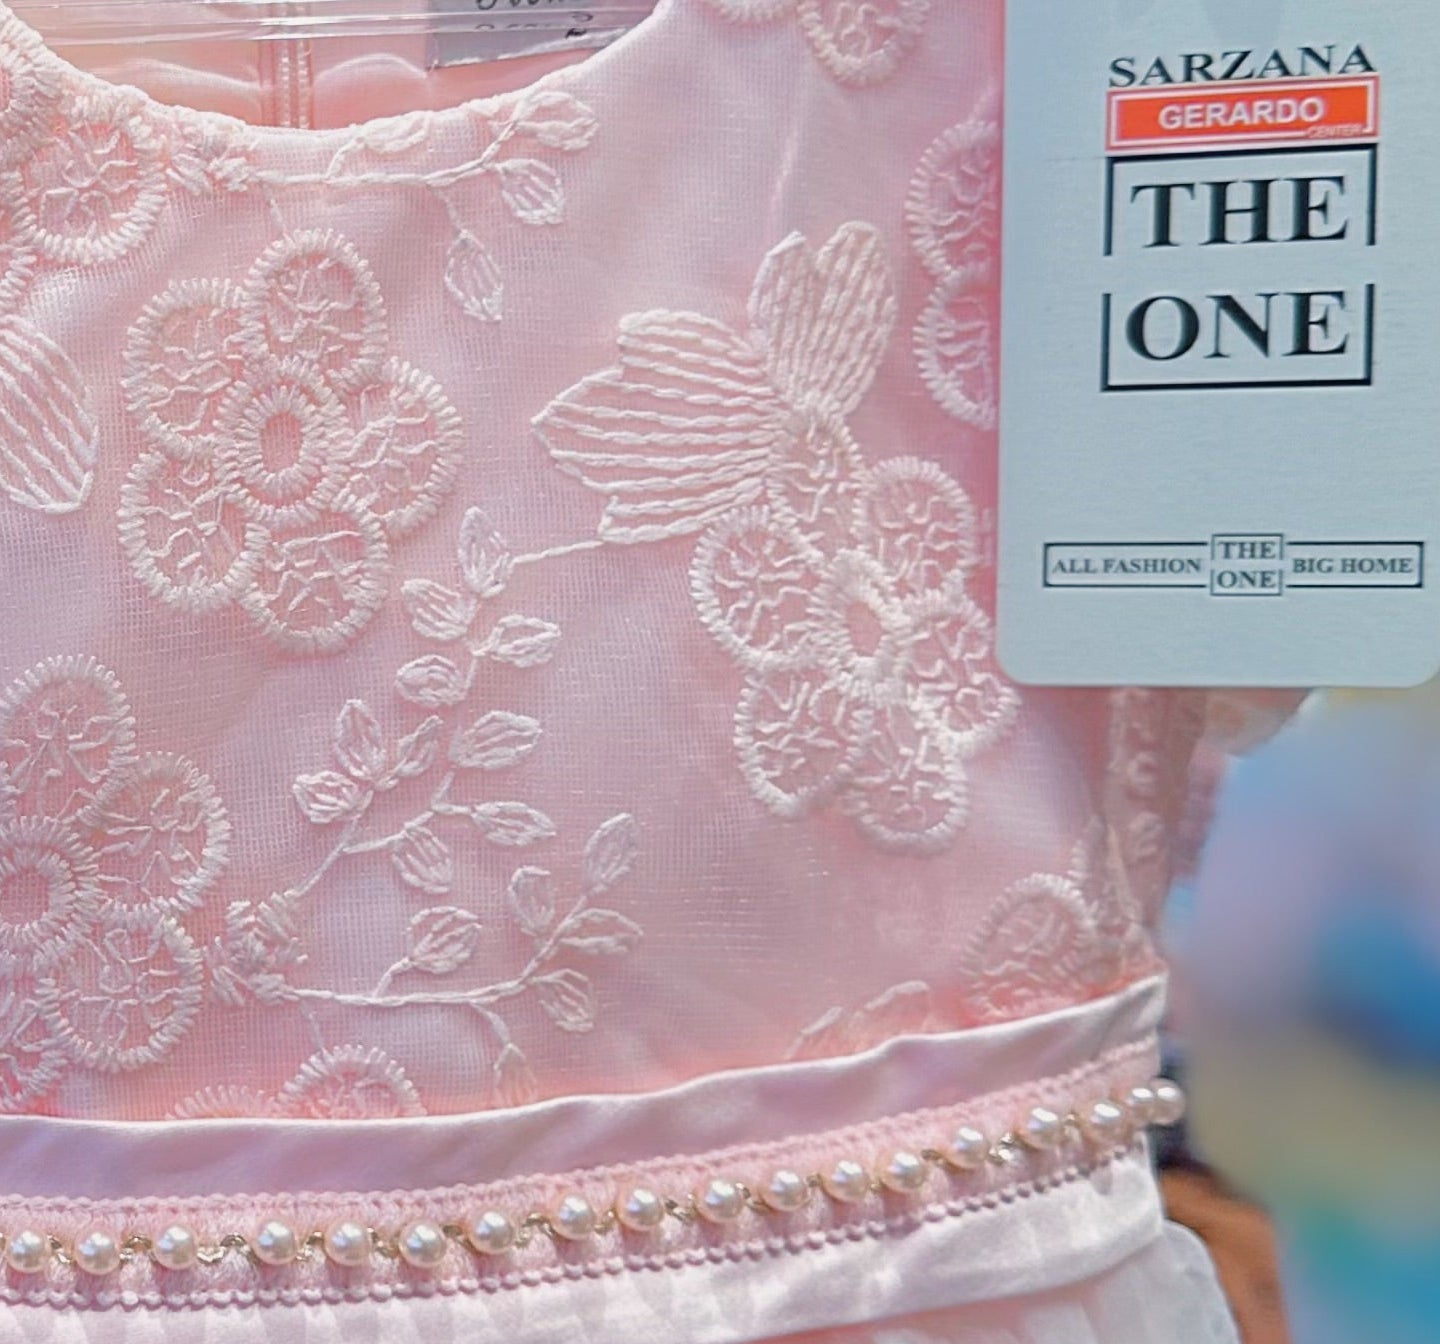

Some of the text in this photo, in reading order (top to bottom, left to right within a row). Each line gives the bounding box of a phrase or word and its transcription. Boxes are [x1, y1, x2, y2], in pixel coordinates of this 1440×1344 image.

[1109, 44, 1377, 88] SARZANA
[1158, 96, 1325, 130] GERARDO
[1130, 174, 1349, 248] THE
[1125, 290, 1350, 361] ONE
[1217, 541, 1276, 560] THE
[1052, 558, 1203, 575] ALL FASHION
[1292, 557, 1414, 575] BIG HOME
[1217, 570, 1278, 590] ONE
